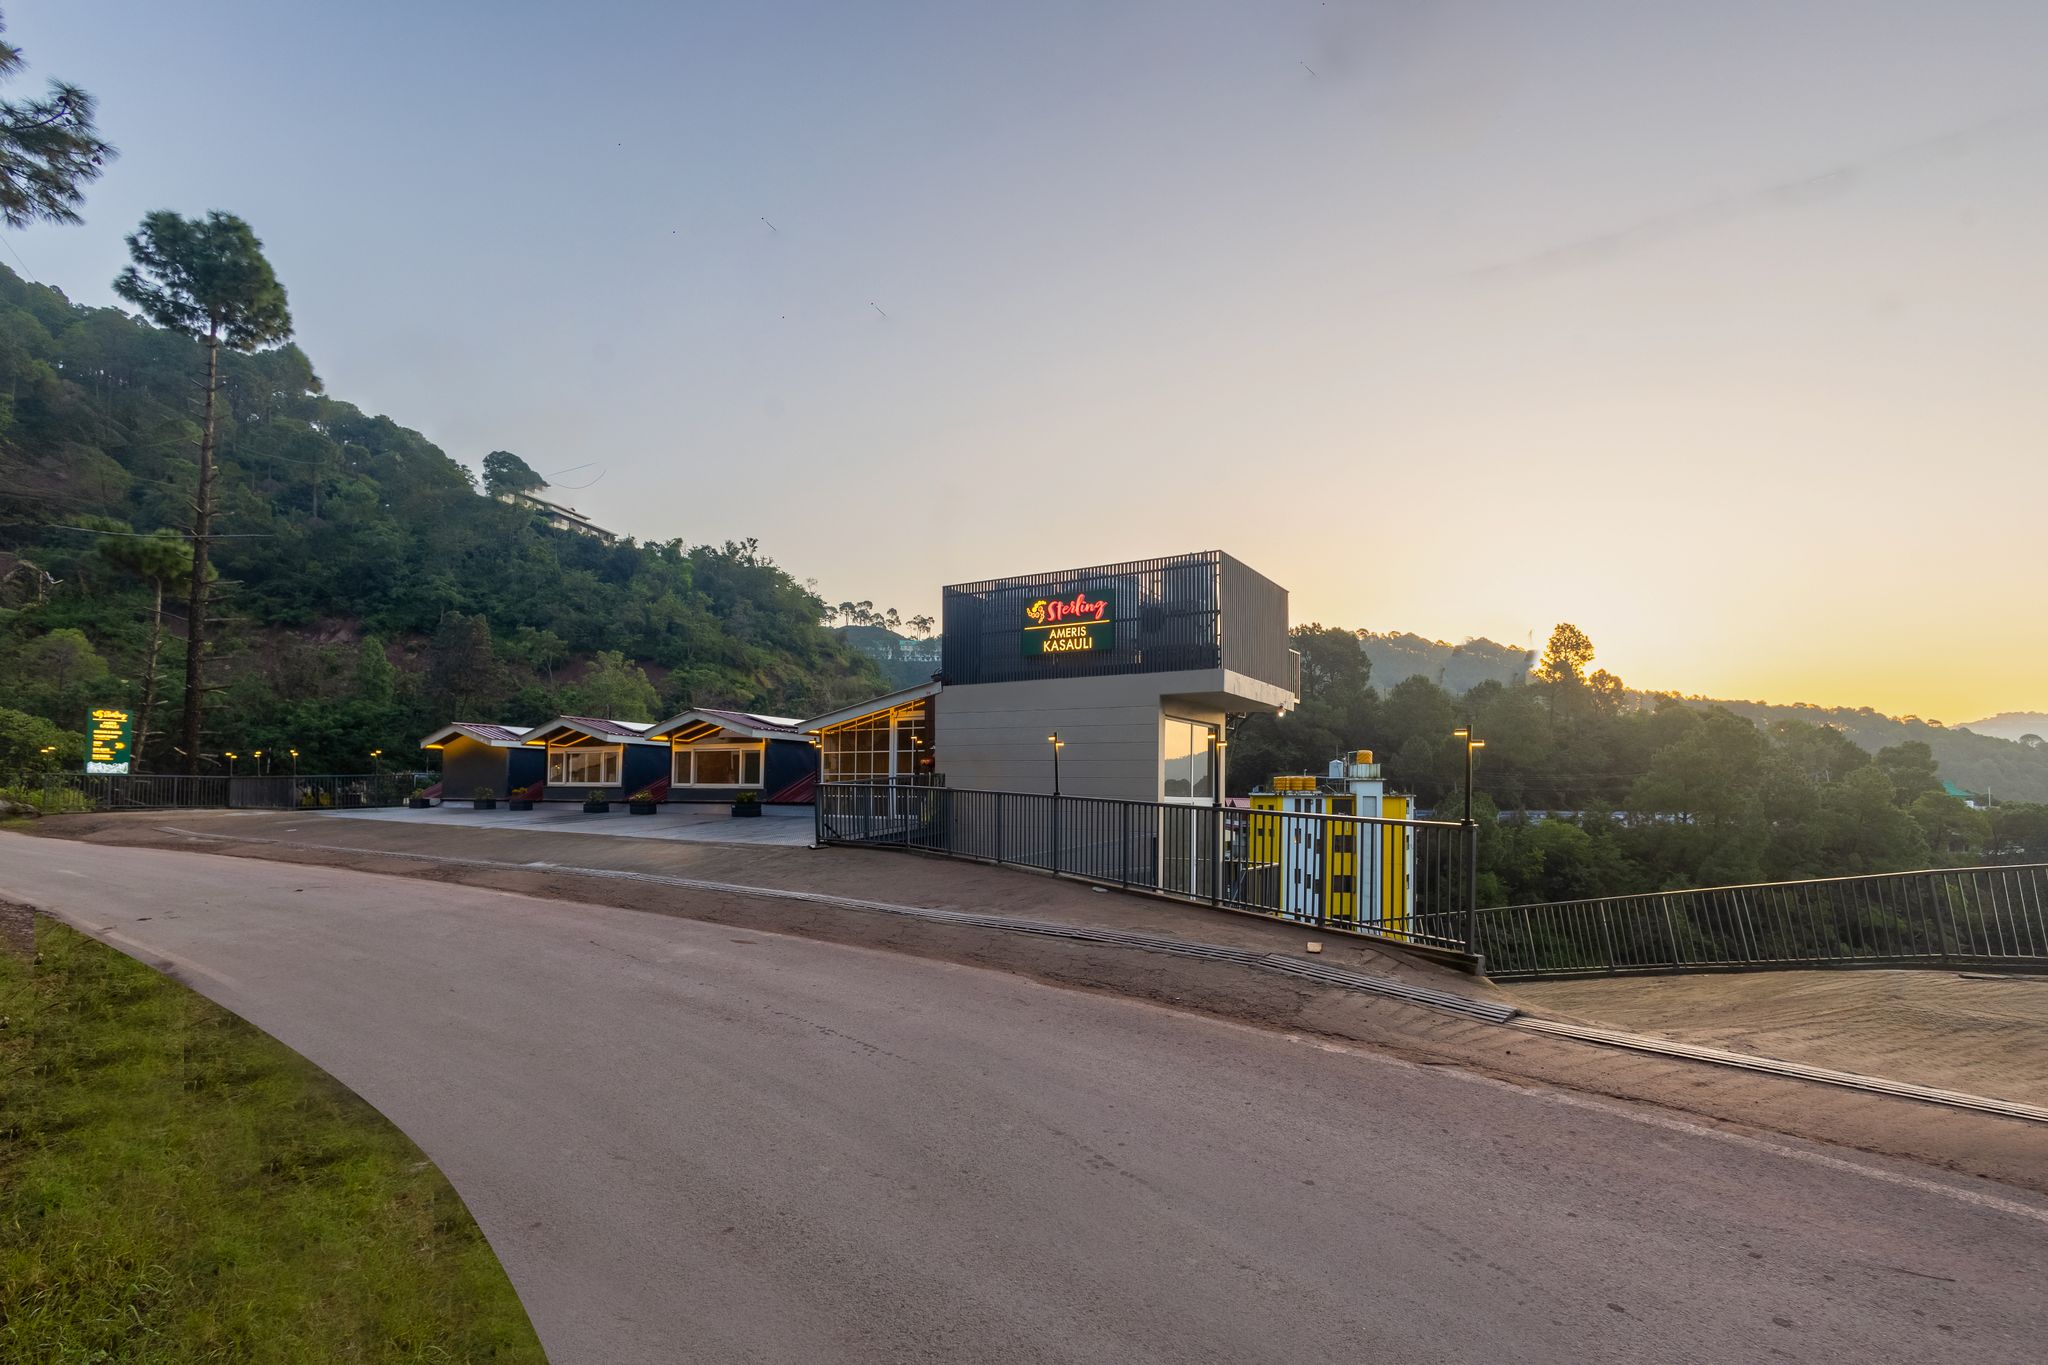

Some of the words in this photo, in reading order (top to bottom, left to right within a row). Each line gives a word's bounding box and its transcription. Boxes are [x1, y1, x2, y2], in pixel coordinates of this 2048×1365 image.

[1047, 593, 1108, 622] Sterling
[1049, 626, 1087, 639] AMERIS
[1043, 637, 1092, 652] KASAULI
